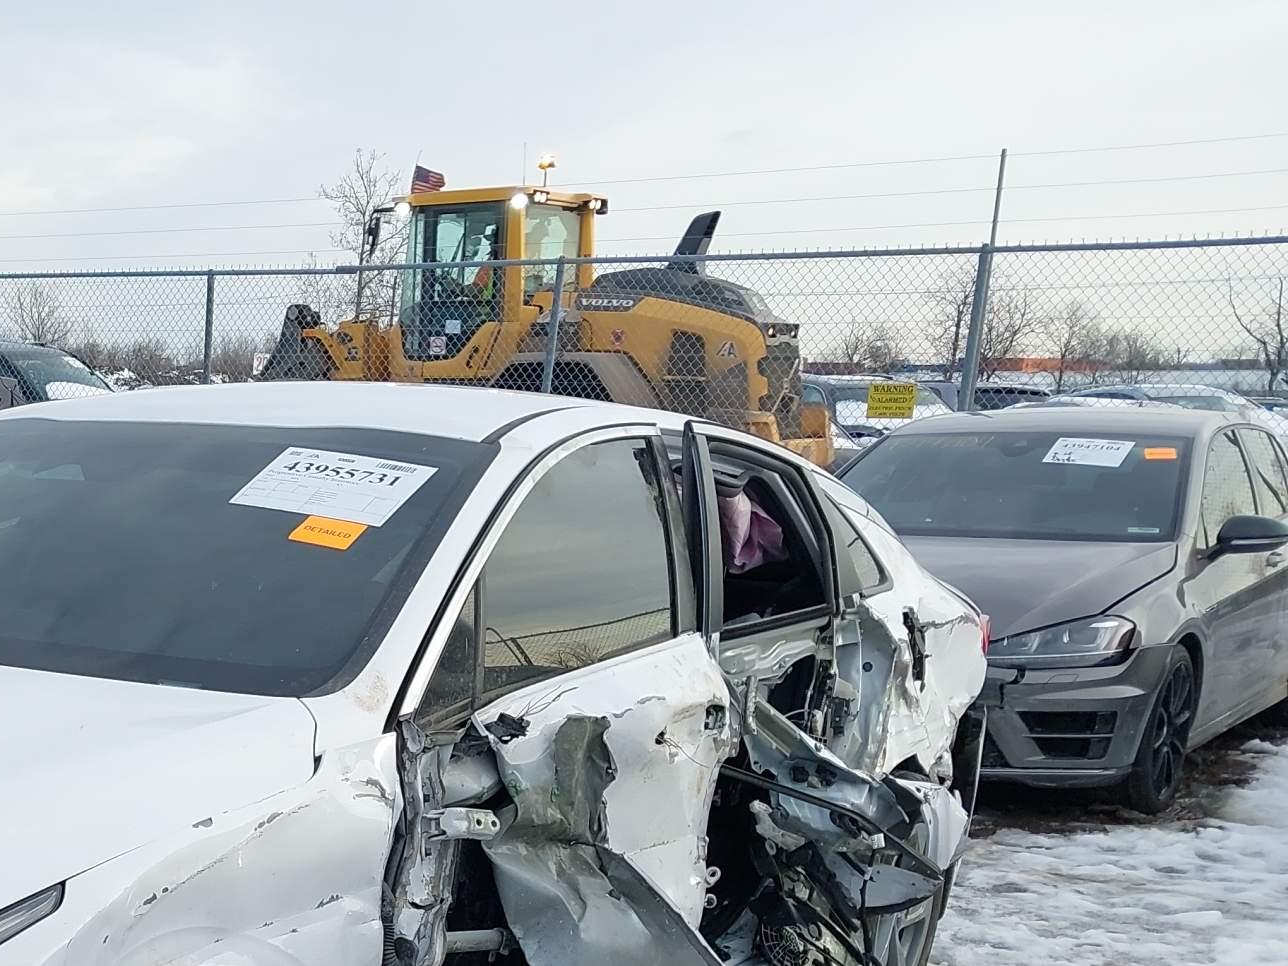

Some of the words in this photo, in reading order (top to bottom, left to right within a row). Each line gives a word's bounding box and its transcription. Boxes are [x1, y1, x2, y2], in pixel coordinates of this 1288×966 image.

[581, 298, 633, 307] VOLVO
[873, 384, 914, 393] WARNING
[283, 460, 402, 487] 43955731
[303, 524, 352, 540] DETAILED
